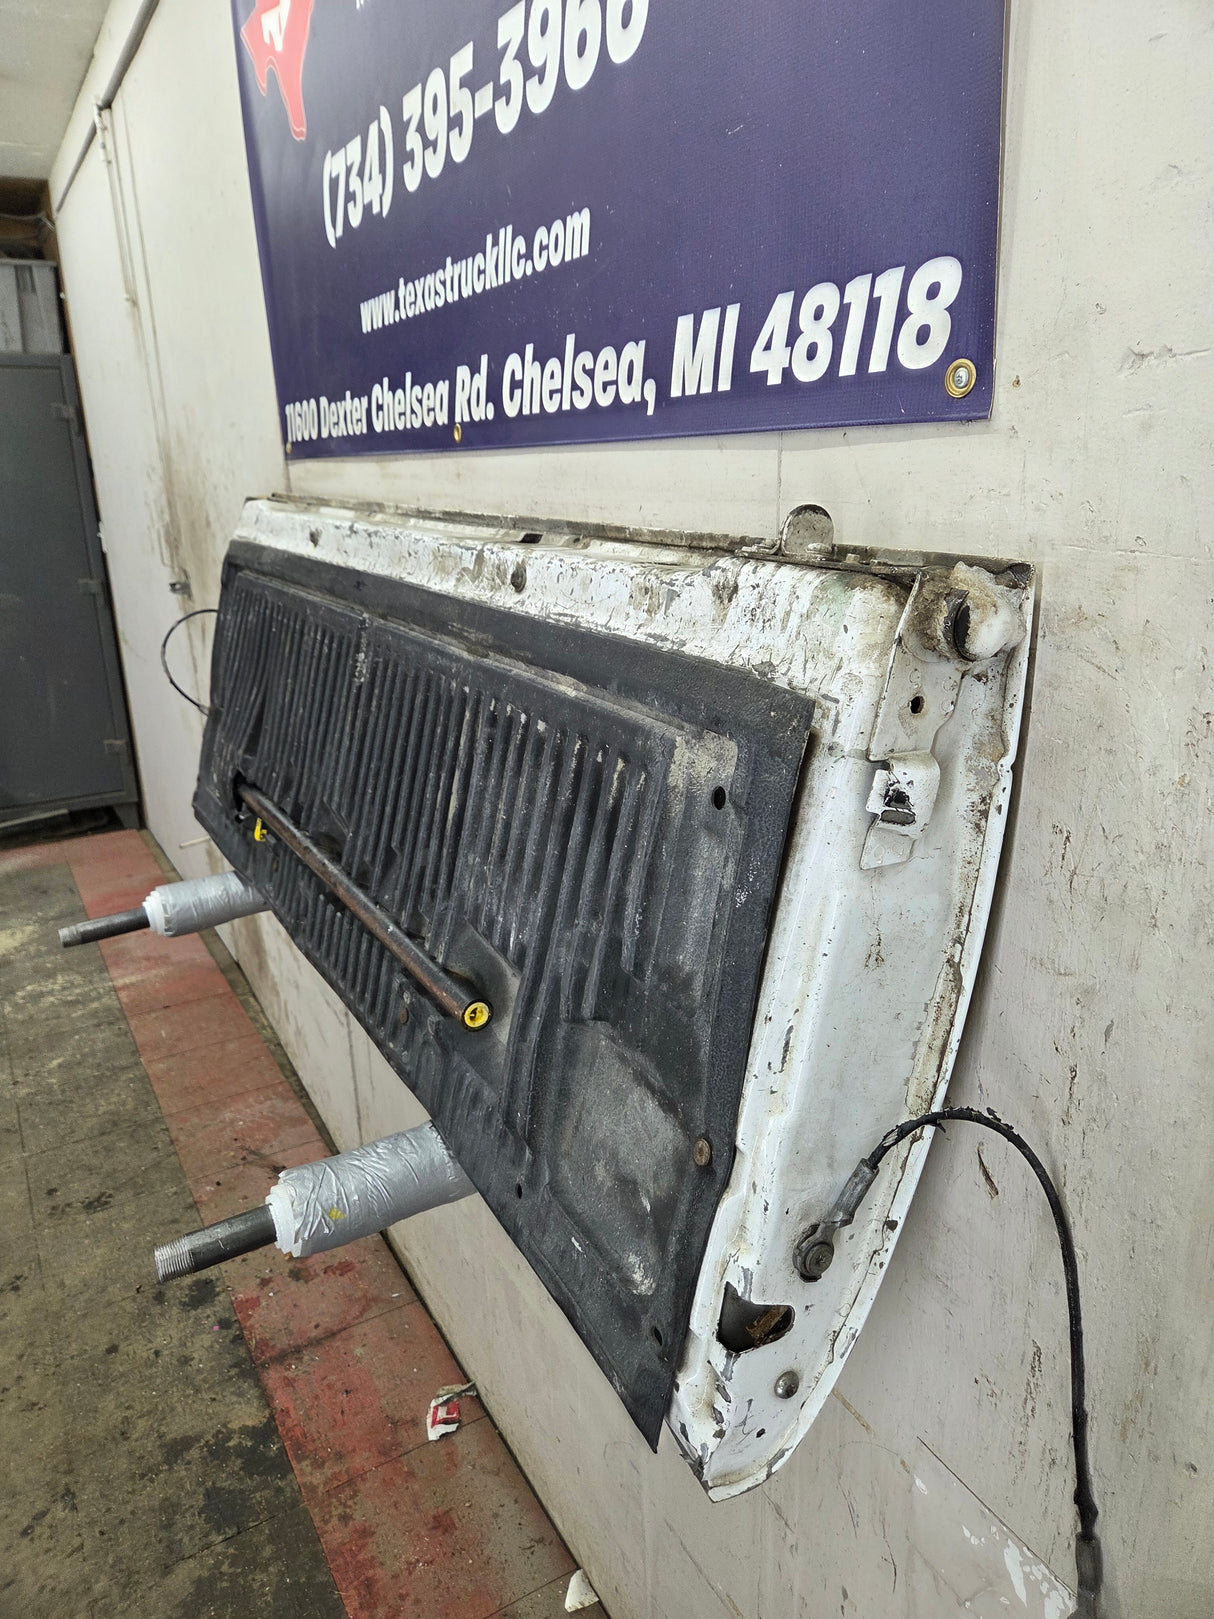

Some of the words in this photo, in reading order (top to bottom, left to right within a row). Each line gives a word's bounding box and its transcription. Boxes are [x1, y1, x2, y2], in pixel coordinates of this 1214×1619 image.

[323, 105, 393, 248] (734)
[360, 207, 591, 333] www.texastruckllc.com
[285, 398, 318, 442] 11600
[319, 390, 368, 438] Dexter
[371, 371, 450, 433] Chelsea
[454, 354, 494, 423] Rd.
[502, 333, 656, 415] Chelsea,
[670, 303, 740, 398] MI
[750, 255, 963, 386] 48118
